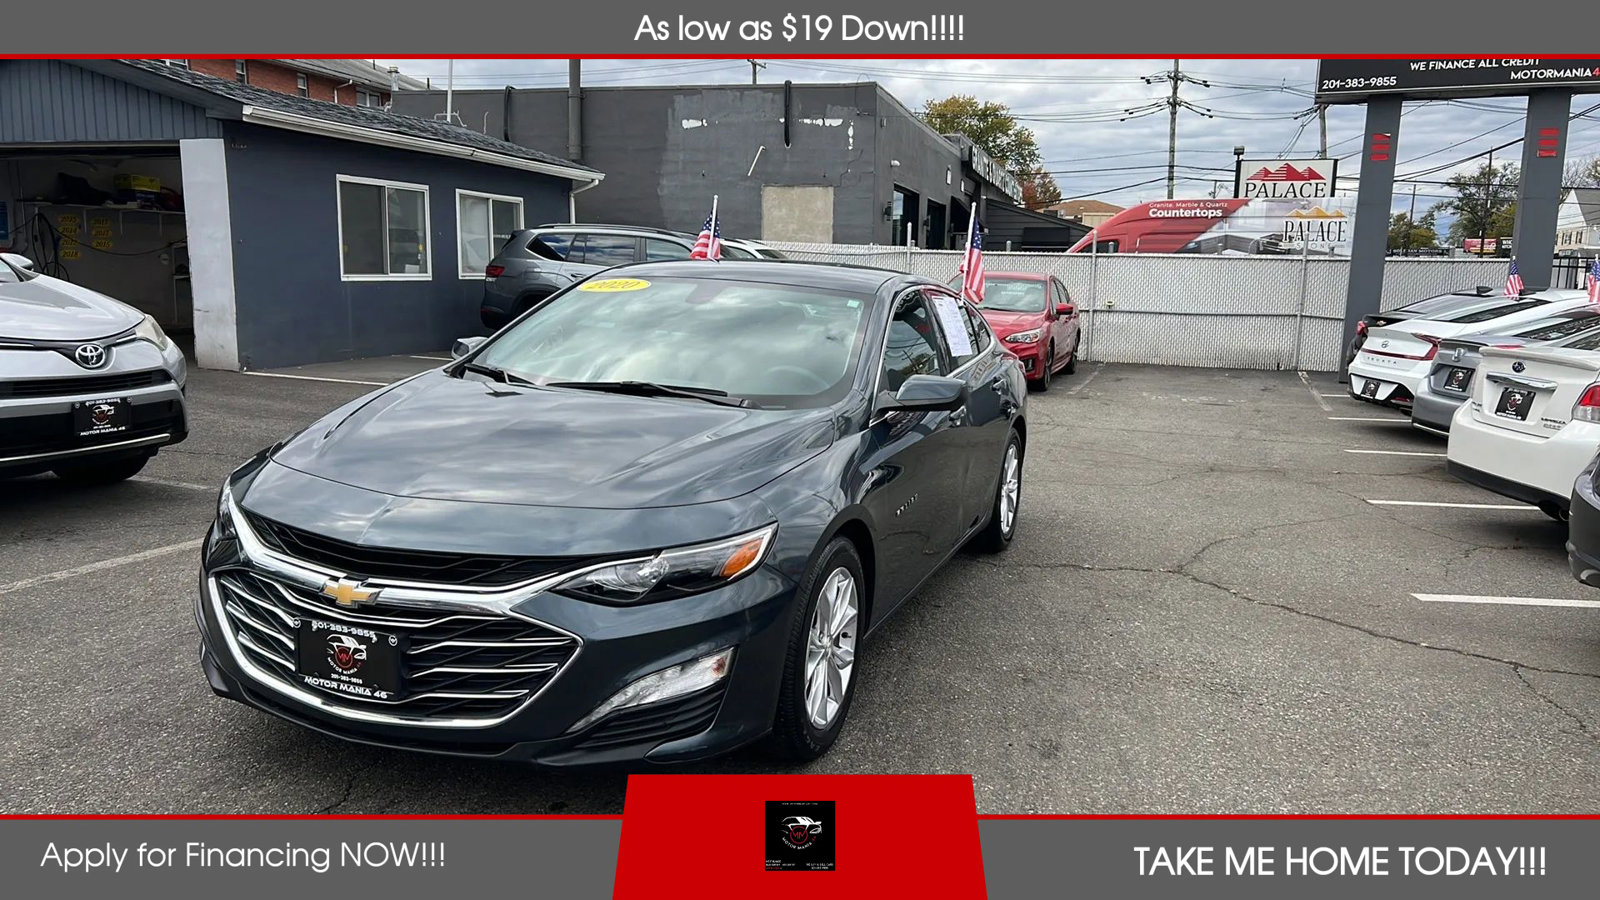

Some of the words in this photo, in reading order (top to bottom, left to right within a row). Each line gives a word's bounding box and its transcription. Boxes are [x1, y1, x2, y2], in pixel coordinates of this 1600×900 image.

[1410, 61, 1427, 71] WE
[1429, 59, 1476, 70] FINANCE
[1478, 59, 1499, 68] ALL
[1501, 59, 1540, 67] CREDIT
[1322, 76, 1397, 89] 201-383-9855
[1244, 182, 1327, 199] PALACE
[1148, 208, 1223, 219] Countertops
[1283, 220, 1348, 242] PALACE
[304, 676, 338, 689] MOTOR
[339, 683, 372, 696] MANIA
[373, 691, 388, 699] 46
